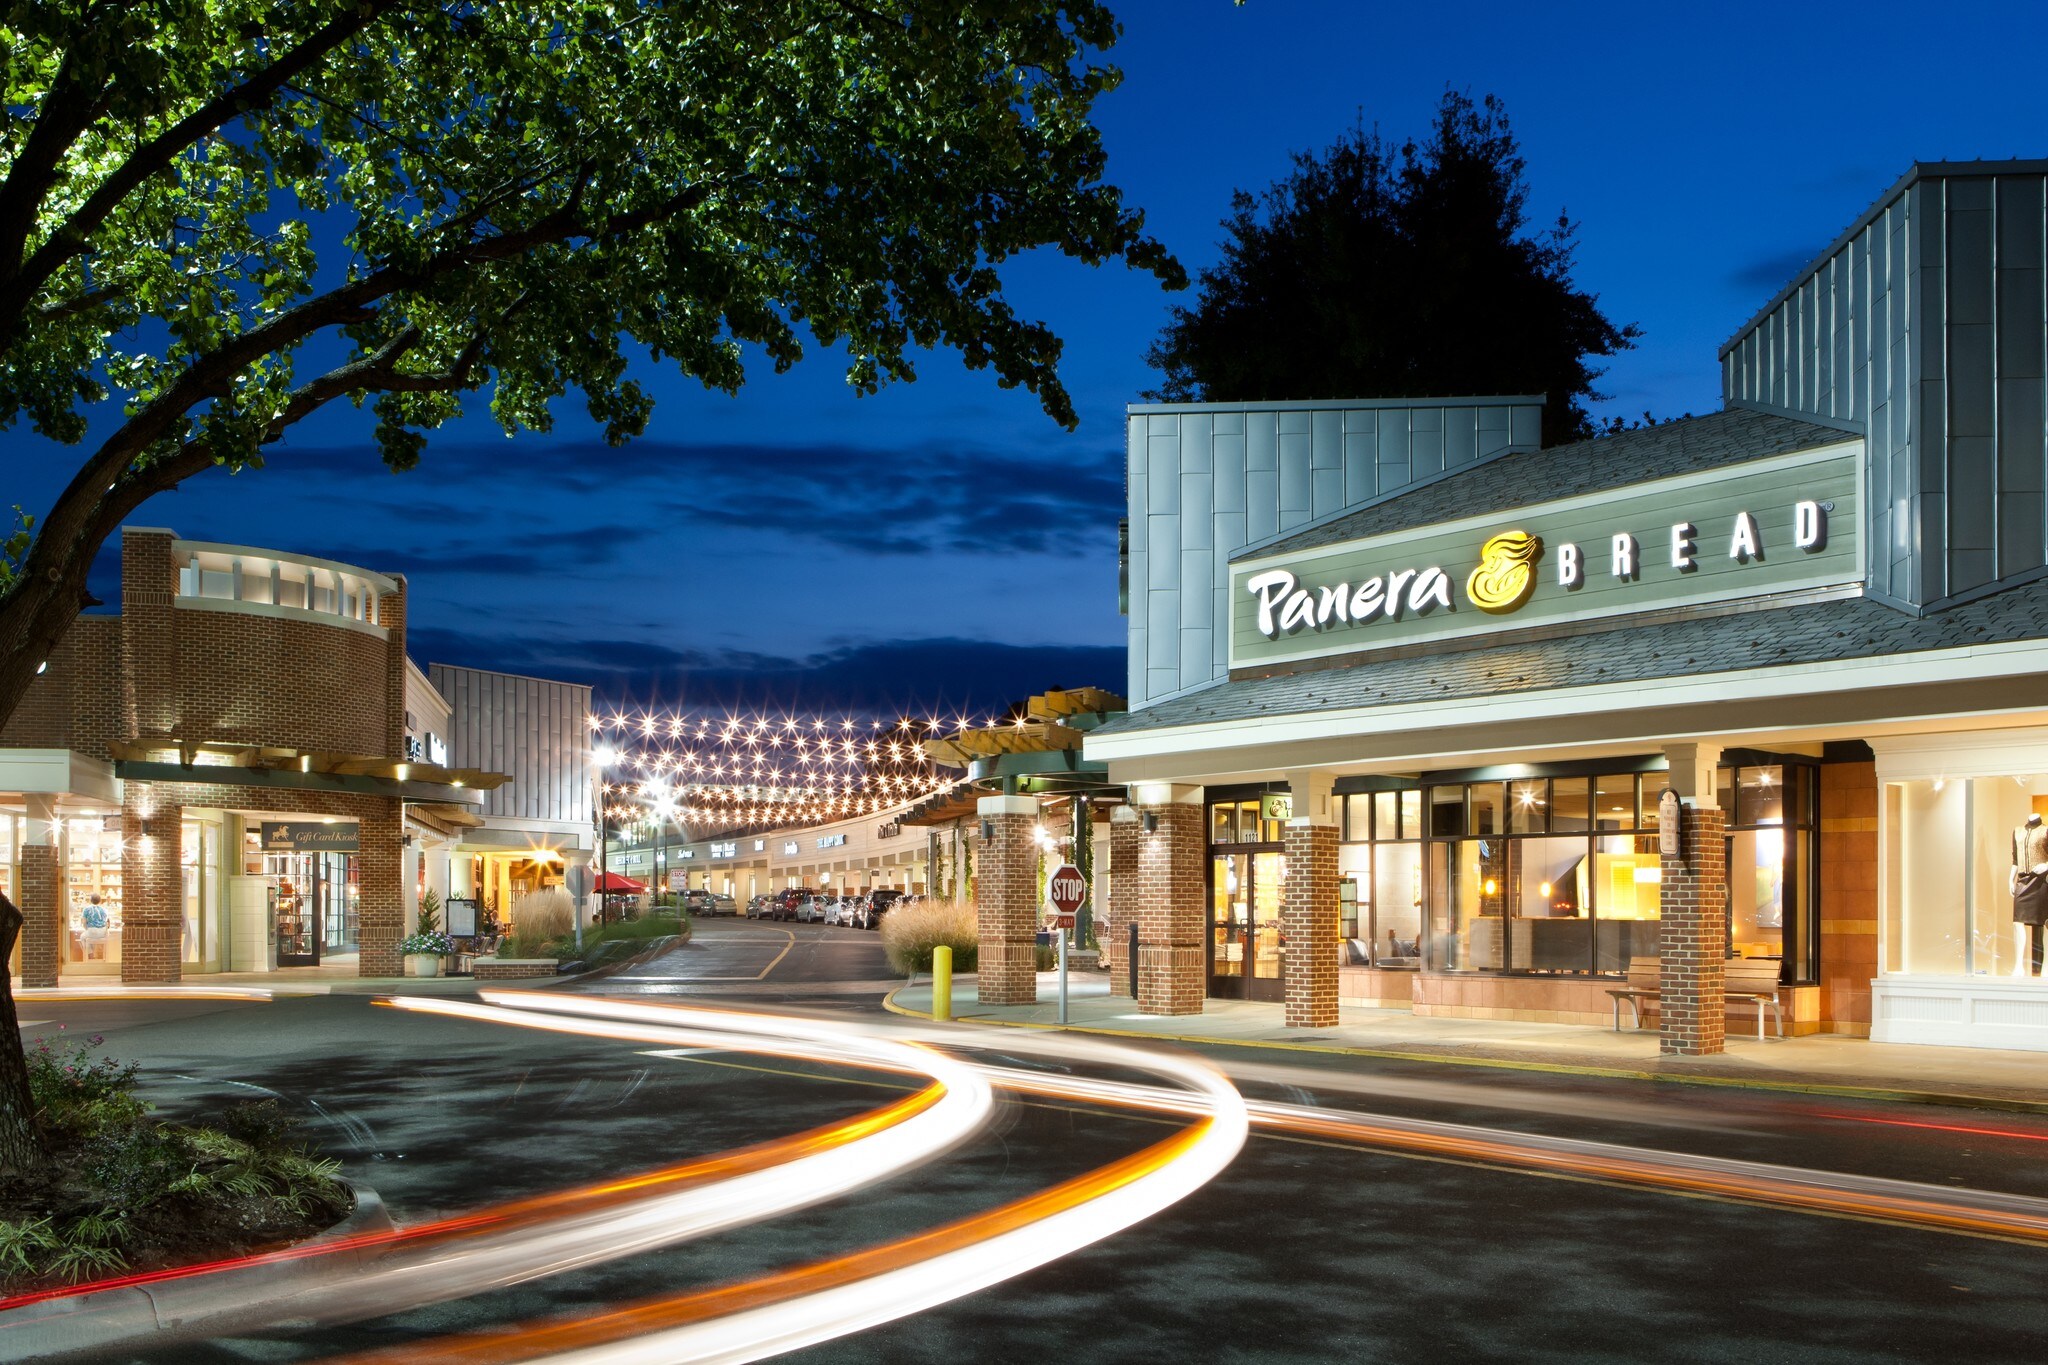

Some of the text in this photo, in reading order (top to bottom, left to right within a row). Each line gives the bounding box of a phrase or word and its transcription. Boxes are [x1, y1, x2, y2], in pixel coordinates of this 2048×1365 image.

[1247, 500, 1822, 637] Panera BREAD
[295, 832, 358, 843] Gift Card Kiosk
[1245, 832, 1258, 843] 1121
[1053, 878, 1083, 901] STOP
